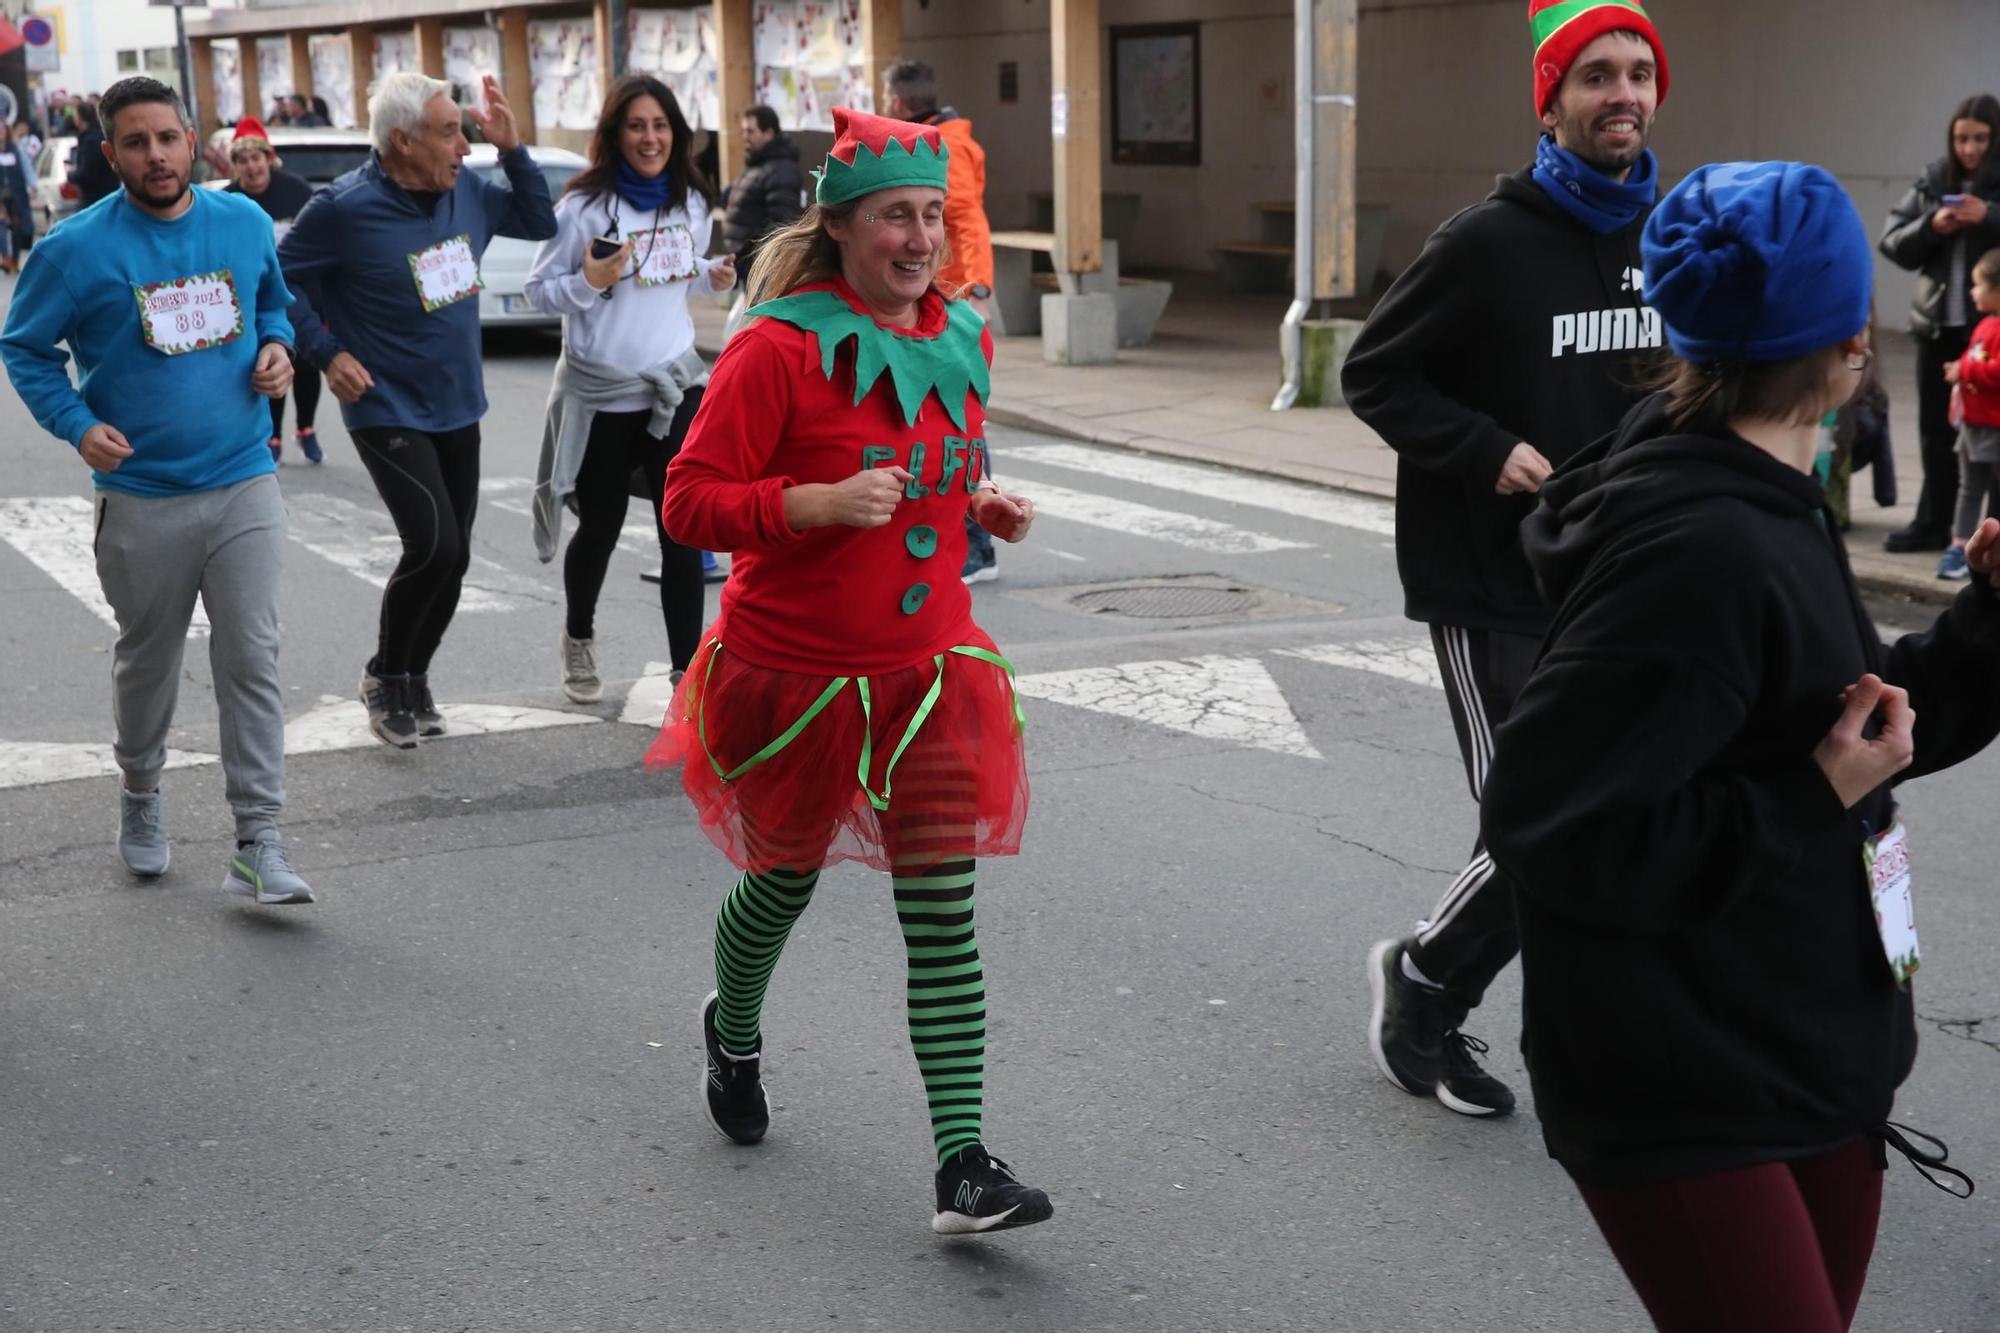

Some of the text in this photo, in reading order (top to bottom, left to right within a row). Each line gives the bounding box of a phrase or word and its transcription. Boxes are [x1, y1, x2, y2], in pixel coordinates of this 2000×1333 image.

[175, 310, 206, 333] 88
[1552, 306, 1663, 357] PUMA
[954, 1179, 984, 1215] N
